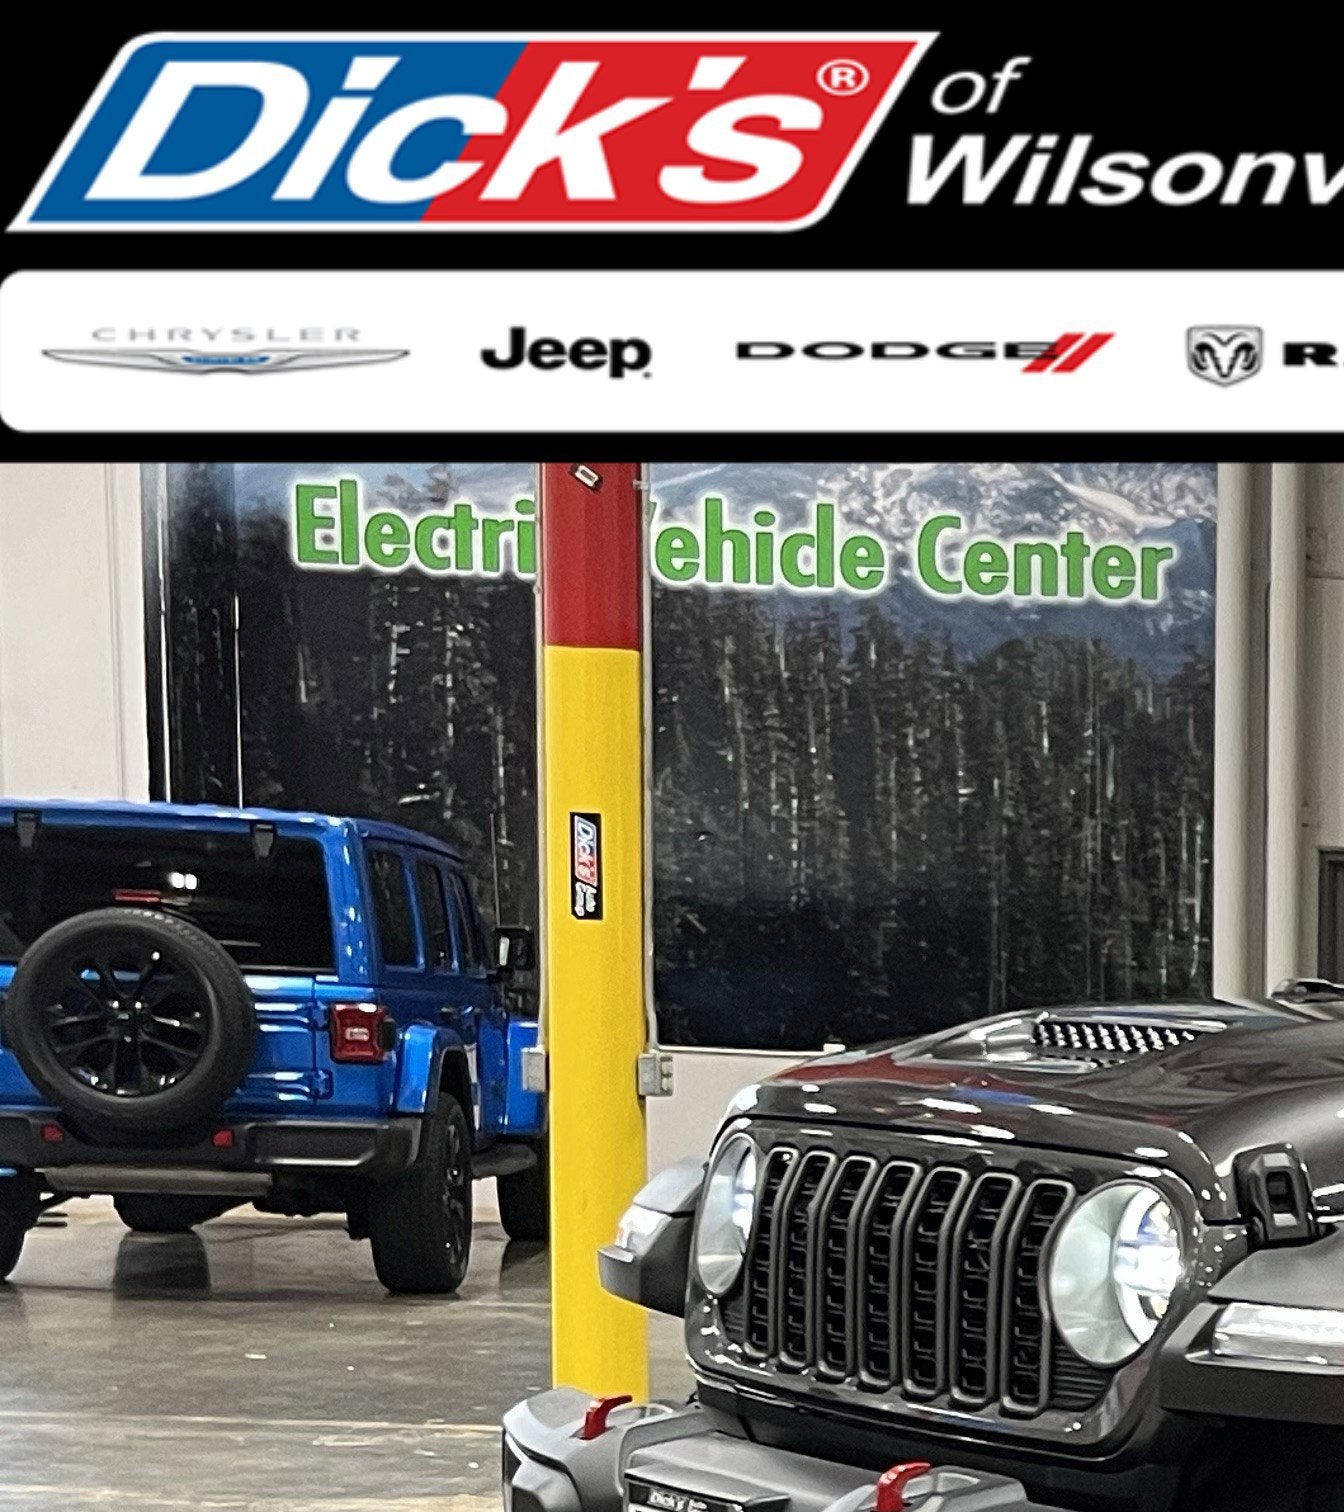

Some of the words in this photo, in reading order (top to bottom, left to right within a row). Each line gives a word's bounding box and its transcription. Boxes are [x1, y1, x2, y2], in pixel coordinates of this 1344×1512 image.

[296, 479, 536, 573] Electri
[650, 497, 885, 589] ehicle
[917, 514, 1174, 601] Center
